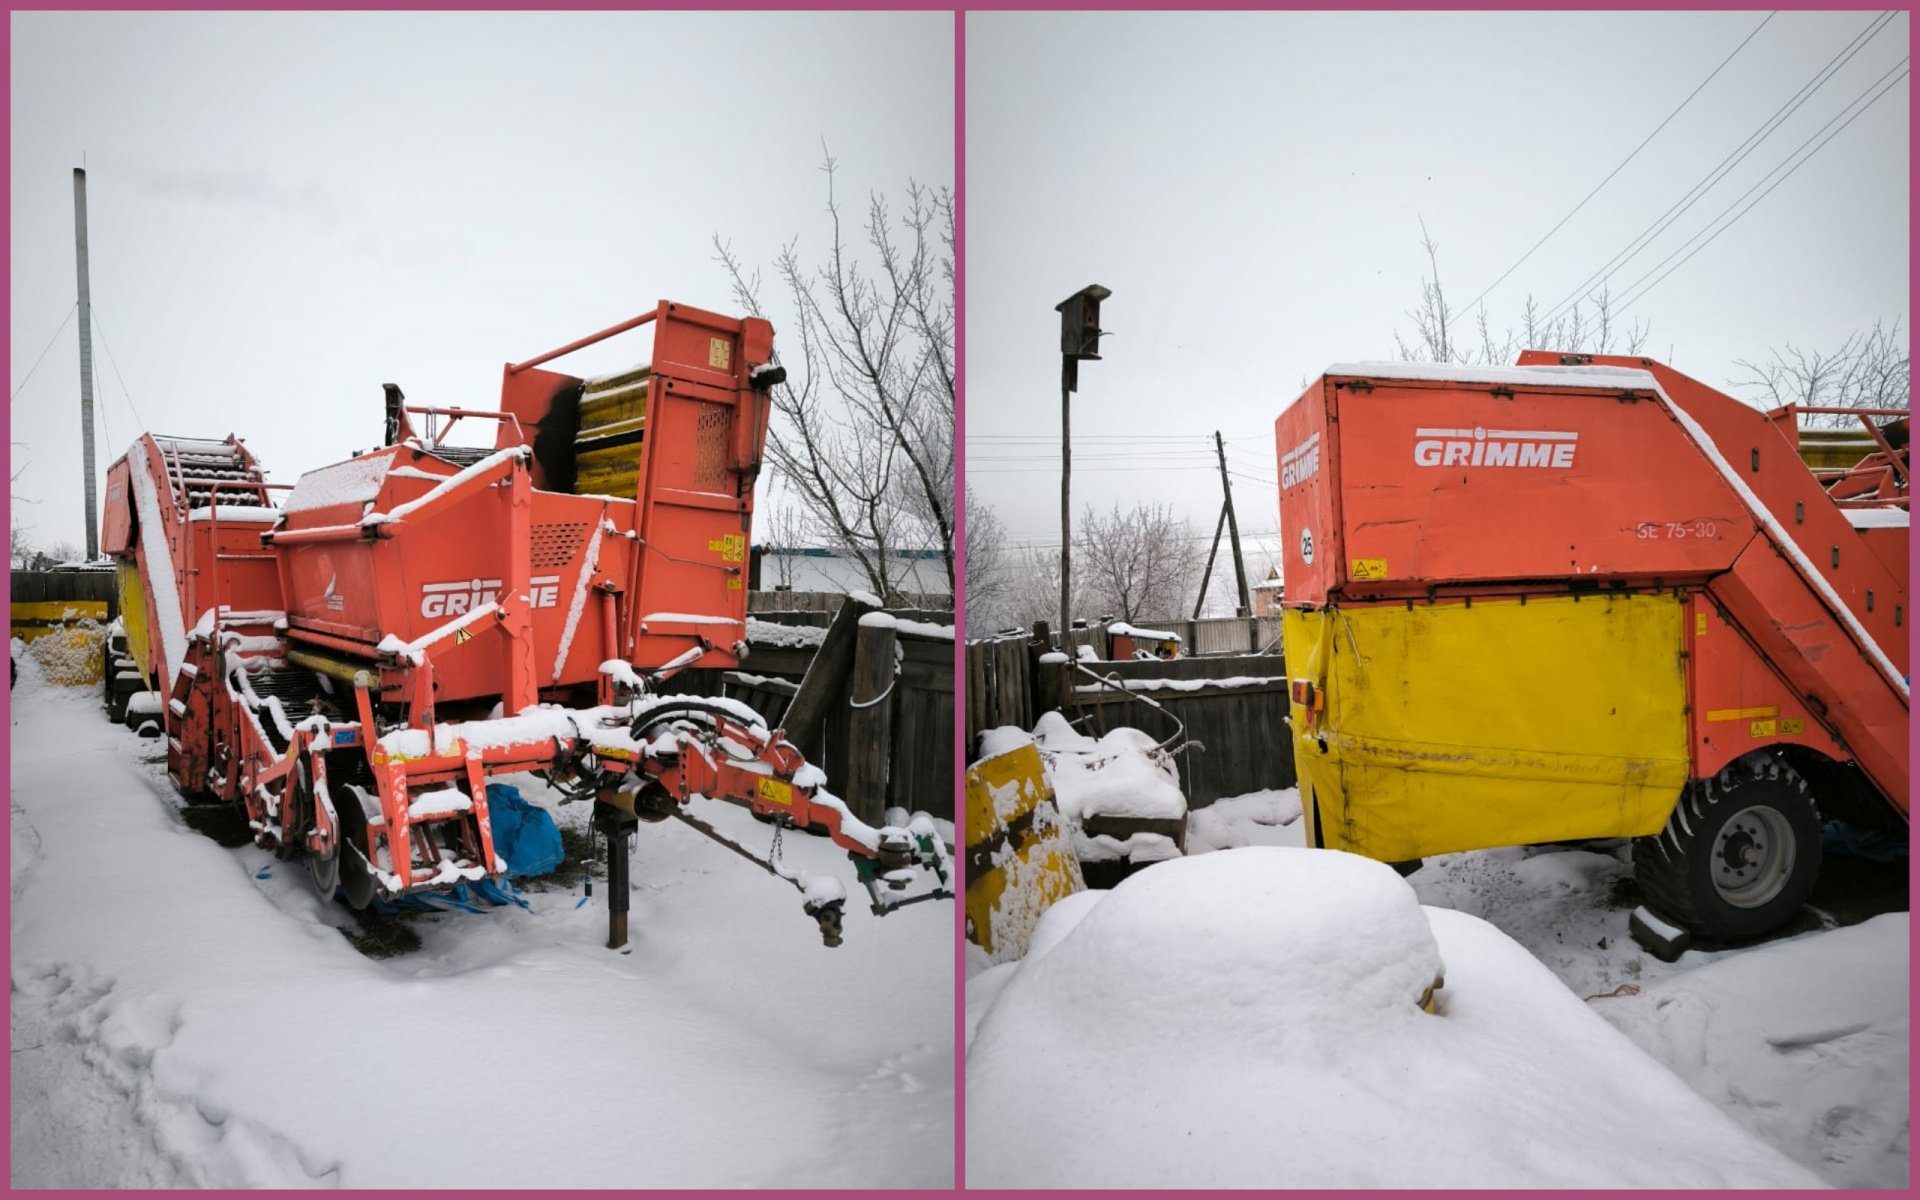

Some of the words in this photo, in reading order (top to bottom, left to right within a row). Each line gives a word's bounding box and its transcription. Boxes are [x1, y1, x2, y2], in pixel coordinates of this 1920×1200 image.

[1281, 432, 1320, 490] GRIMME
[1414, 427, 1578, 468] GRIMME
[1637, 523, 1659, 539] SE
[1666, 522, 1716, 538] 75-30
[1302, 537, 1313, 556] 25
